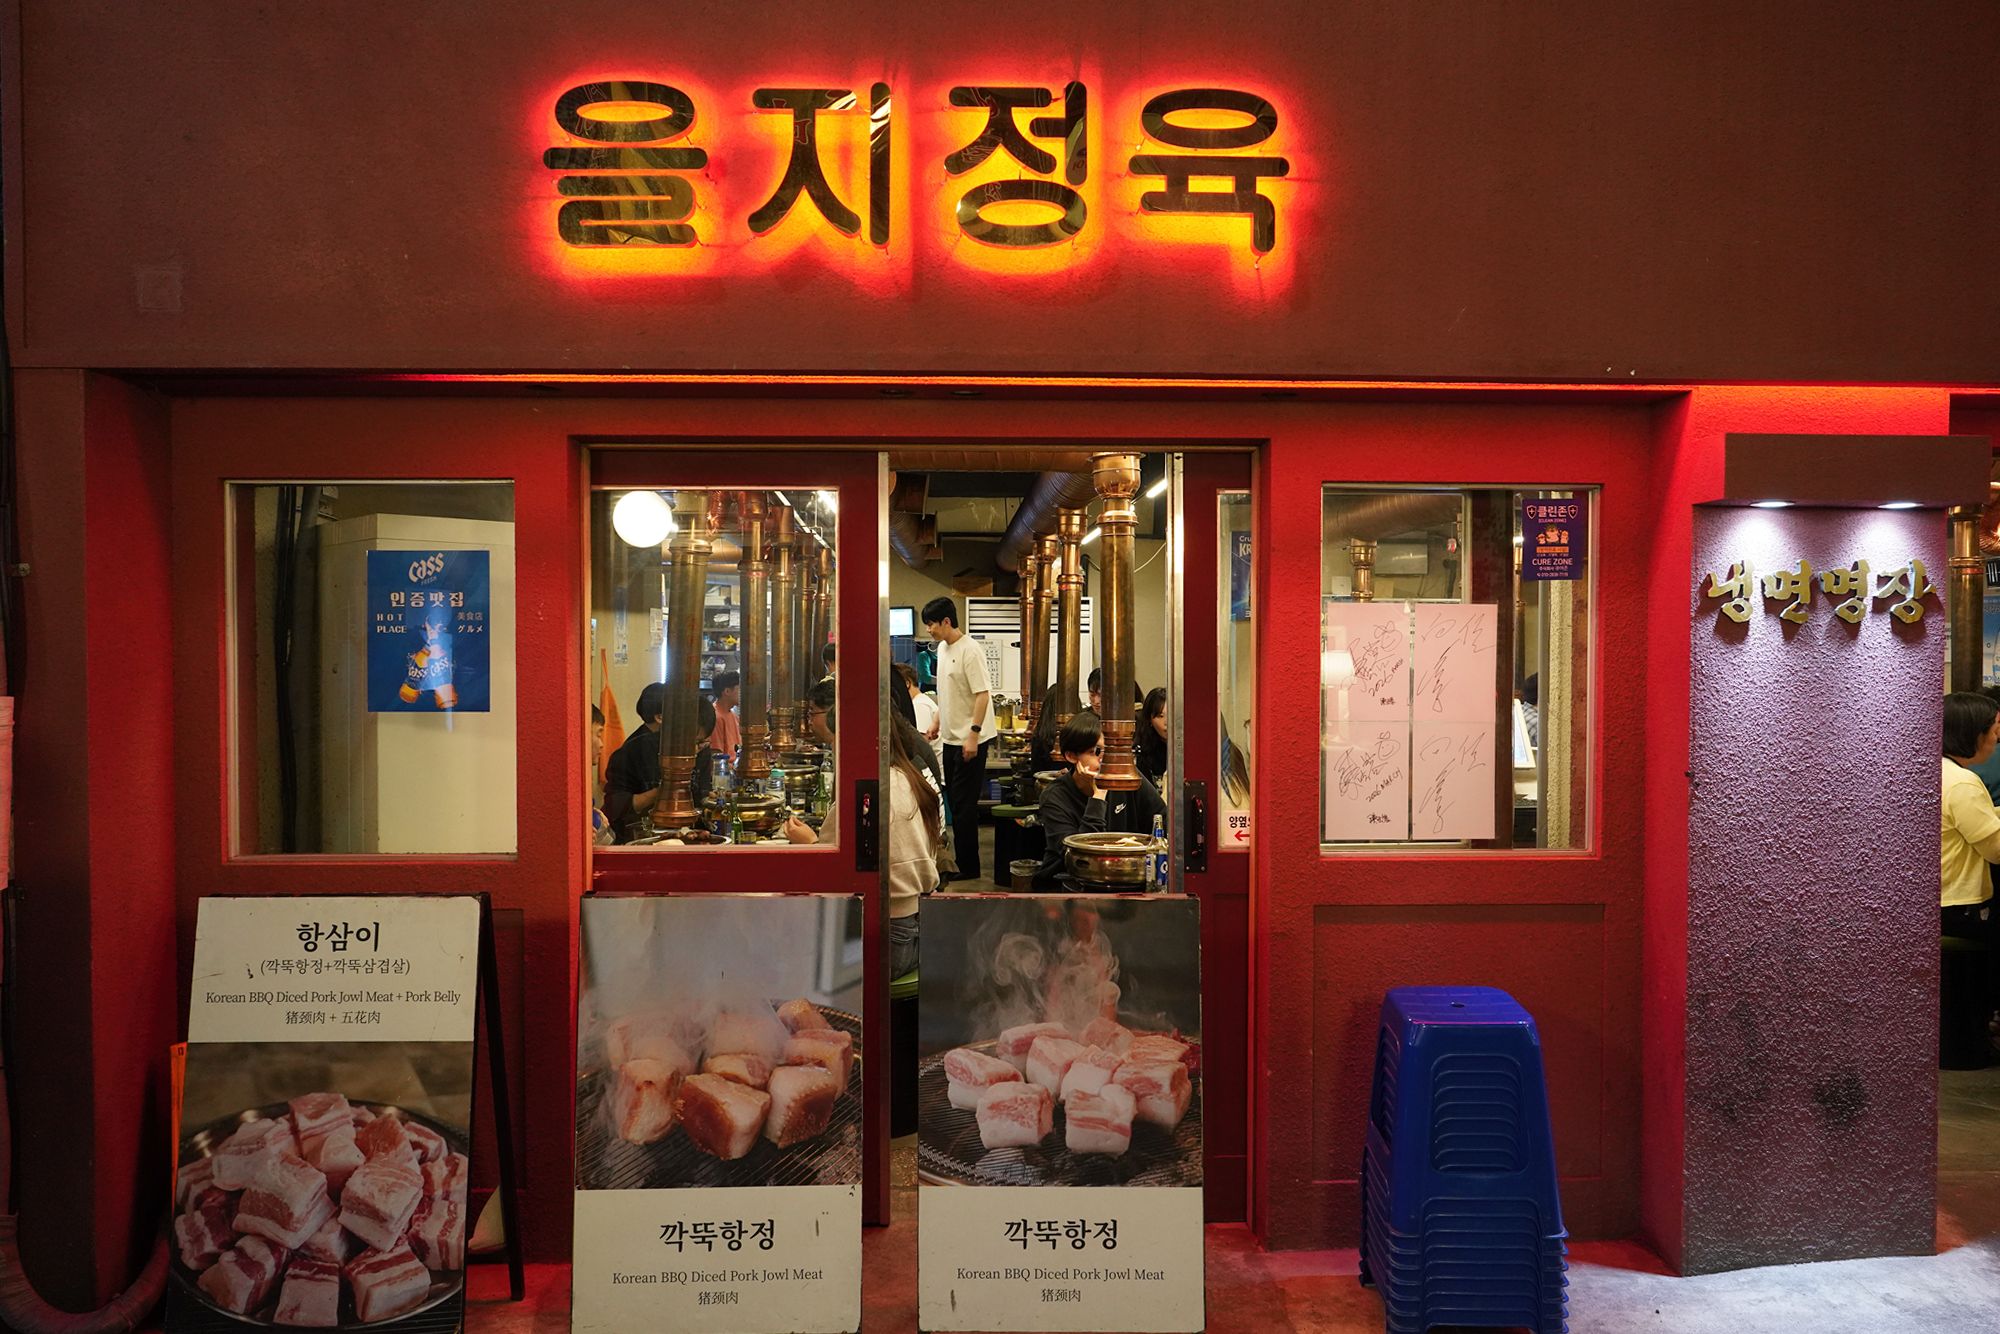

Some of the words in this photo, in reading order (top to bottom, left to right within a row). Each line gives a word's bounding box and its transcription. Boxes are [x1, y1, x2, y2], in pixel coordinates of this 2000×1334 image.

[541, 80, 1291, 255] 을지정육
[1538, 505, 1567, 518] 클린존
[1532, 558, 1551, 566] CURE
[1553, 557, 1574, 566] ZONE
[1707, 559, 1937, 624] 냉면명장
[390, 591, 464, 608] 인증맛집
[376, 613, 404, 621] HOT
[376, 625, 407, 634] PLACE
[457, 624, 483, 633] グルメ
[296, 921, 380, 952] 항삼이
[206, 991, 246, 1004] Korean
[249, 991, 274, 1005] BBQ
[276, 990, 308, 1003] Diced
[311, 990, 337, 1003] Pork
[337, 990, 363, 1004] Jowl
[366, 991, 394, 1003] Meat
[405, 990, 431, 1003] Pork
[434, 990, 461, 1006] Belly
[285, 1010, 326, 1025] 猪颈肉
[341, 1010, 381, 1025] 五花肉
[659, 1218, 776, 1253] 깍뚝항정
[1004, 1218, 1118, 1250] 깍뚝항정
[612, 1272, 657, 1285] Korean
[661, 1271, 688, 1285] BBQ
[691, 1269, 727, 1283] Diced
[730, 1269, 760, 1283] Pork
[760, 1268, 790, 1282] Jowl
[793, 1268, 824, 1281] Meat
[957, 1268, 1001, 1280] Korean
[1004, 1268, 1031, 1282] BBQ
[1034, 1268, 1069, 1280] Diced
[1073, 1267, 1102, 1280] Pork
[1102, 1268, 1131, 1281] Jowl
[1134, 1268, 1165, 1280] Meat
[698, 1290, 740, 1305] 猪颈肉
[1041, 1288, 1082, 1303] 猪颈肉
